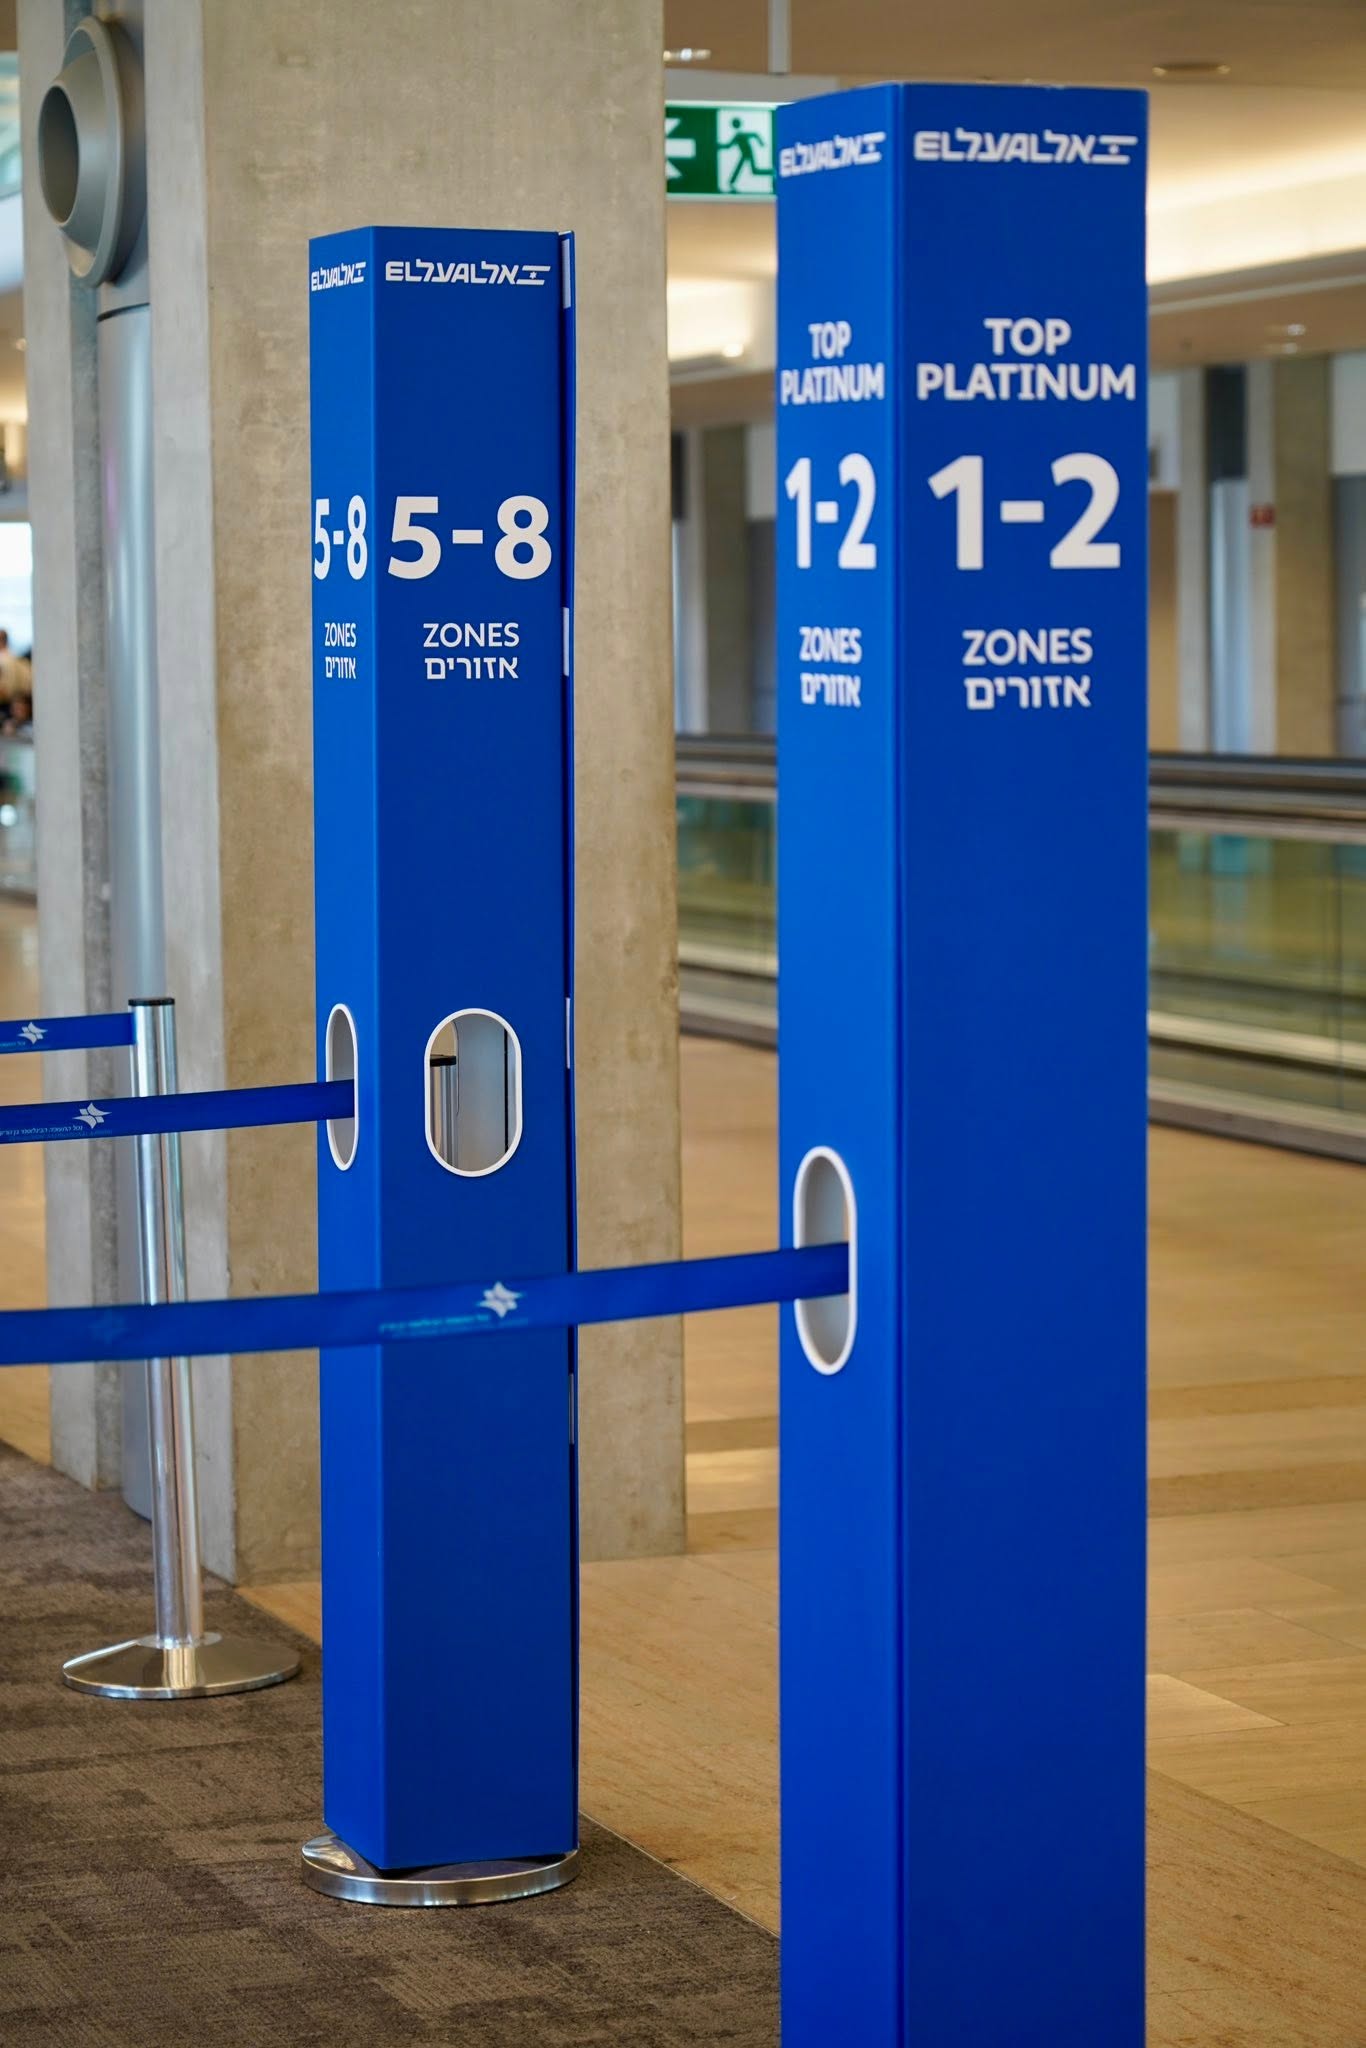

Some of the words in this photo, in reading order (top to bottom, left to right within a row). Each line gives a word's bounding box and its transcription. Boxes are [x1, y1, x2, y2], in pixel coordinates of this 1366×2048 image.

[809, 321, 851, 360] TOP
[984, 317, 1071, 356] TOP
[781, 363, 885, 405] PLATINUM
[917, 363, 1136, 401] PLATINUM
[785, 453, 877, 569] 1-2
[928, 453, 1122, 570] 1-2
[314, 494, 368, 581] 5-8
[387, 495, 552, 580] 5-8
[324, 622, 357, 648] ZONES
[423, 622, 520, 648] ZONES
[799, 626, 862, 664] ZONES
[963, 628, 1093, 665] ZONES
[325, 656, 356, 680] אזורים
[424, 657, 519, 681] אזורים
[800, 672, 861, 708] אזורים
[964, 675, 1091, 710] אזורים
